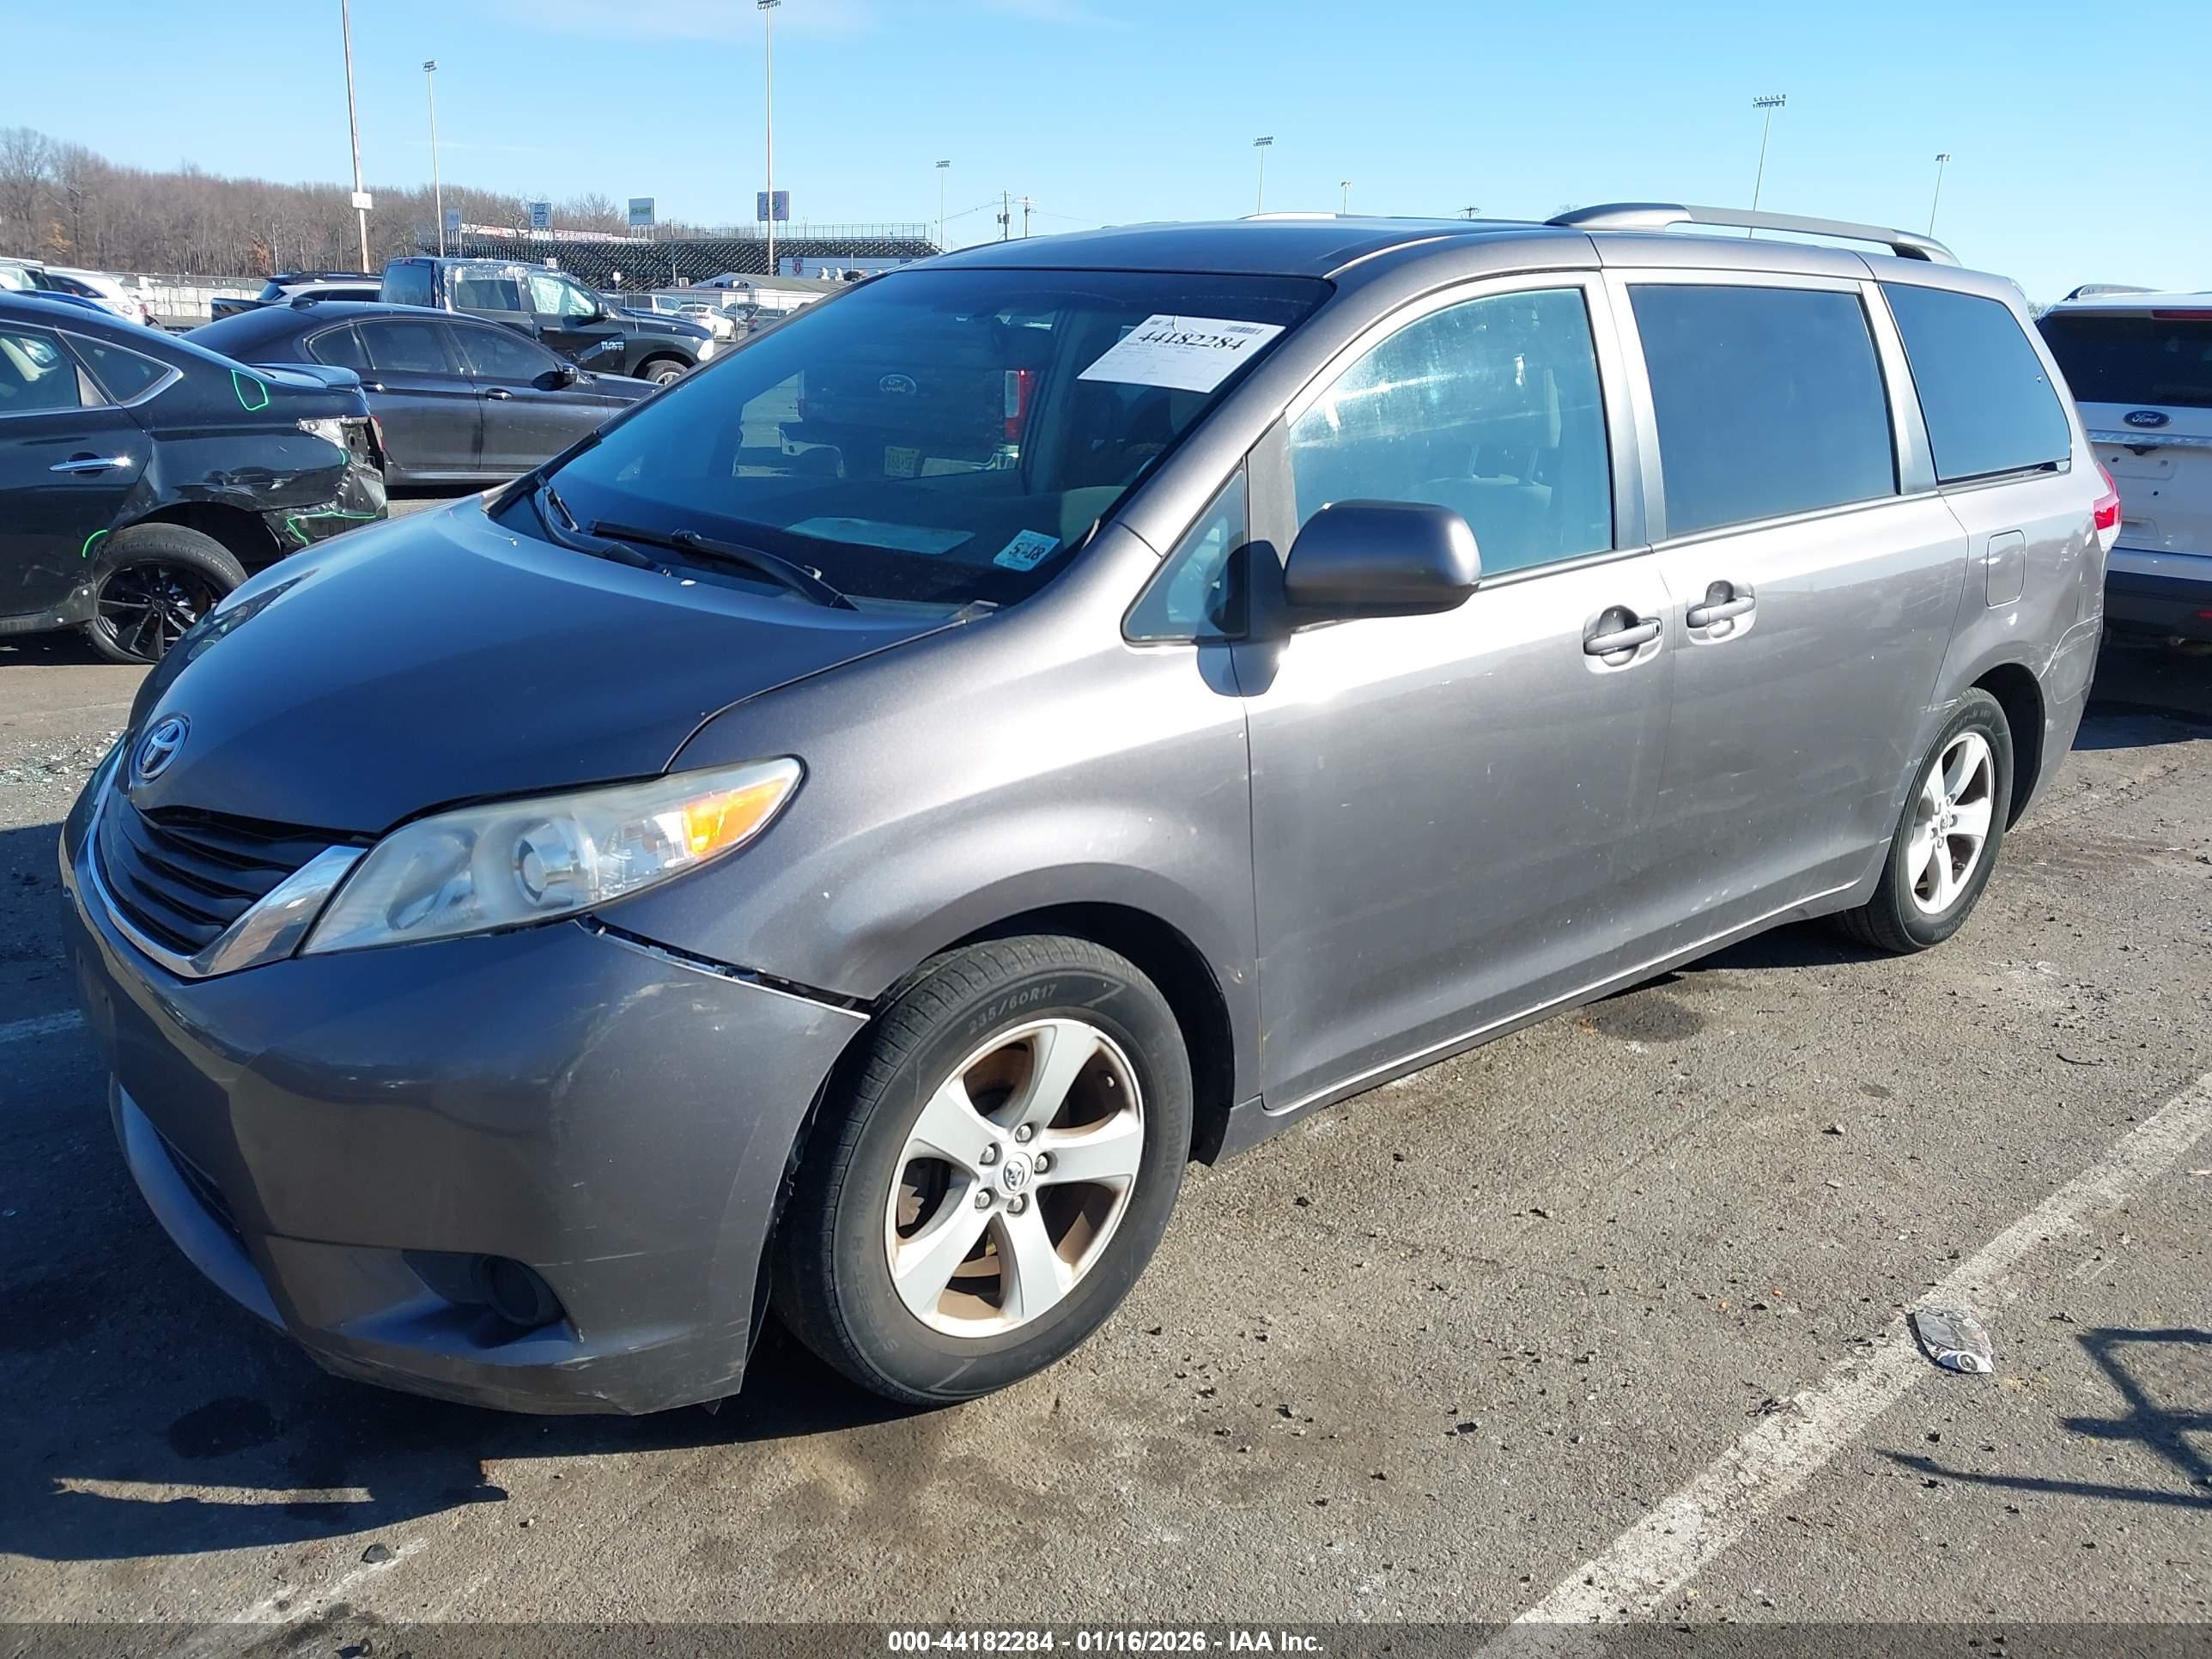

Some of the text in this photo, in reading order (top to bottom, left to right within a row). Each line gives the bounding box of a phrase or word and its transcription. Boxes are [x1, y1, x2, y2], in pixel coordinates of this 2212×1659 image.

[1138, 331, 1246, 350] 44182284
[2131, 412, 2160, 423] Ford
[968, 983, 1057, 1036] 235/60R17
